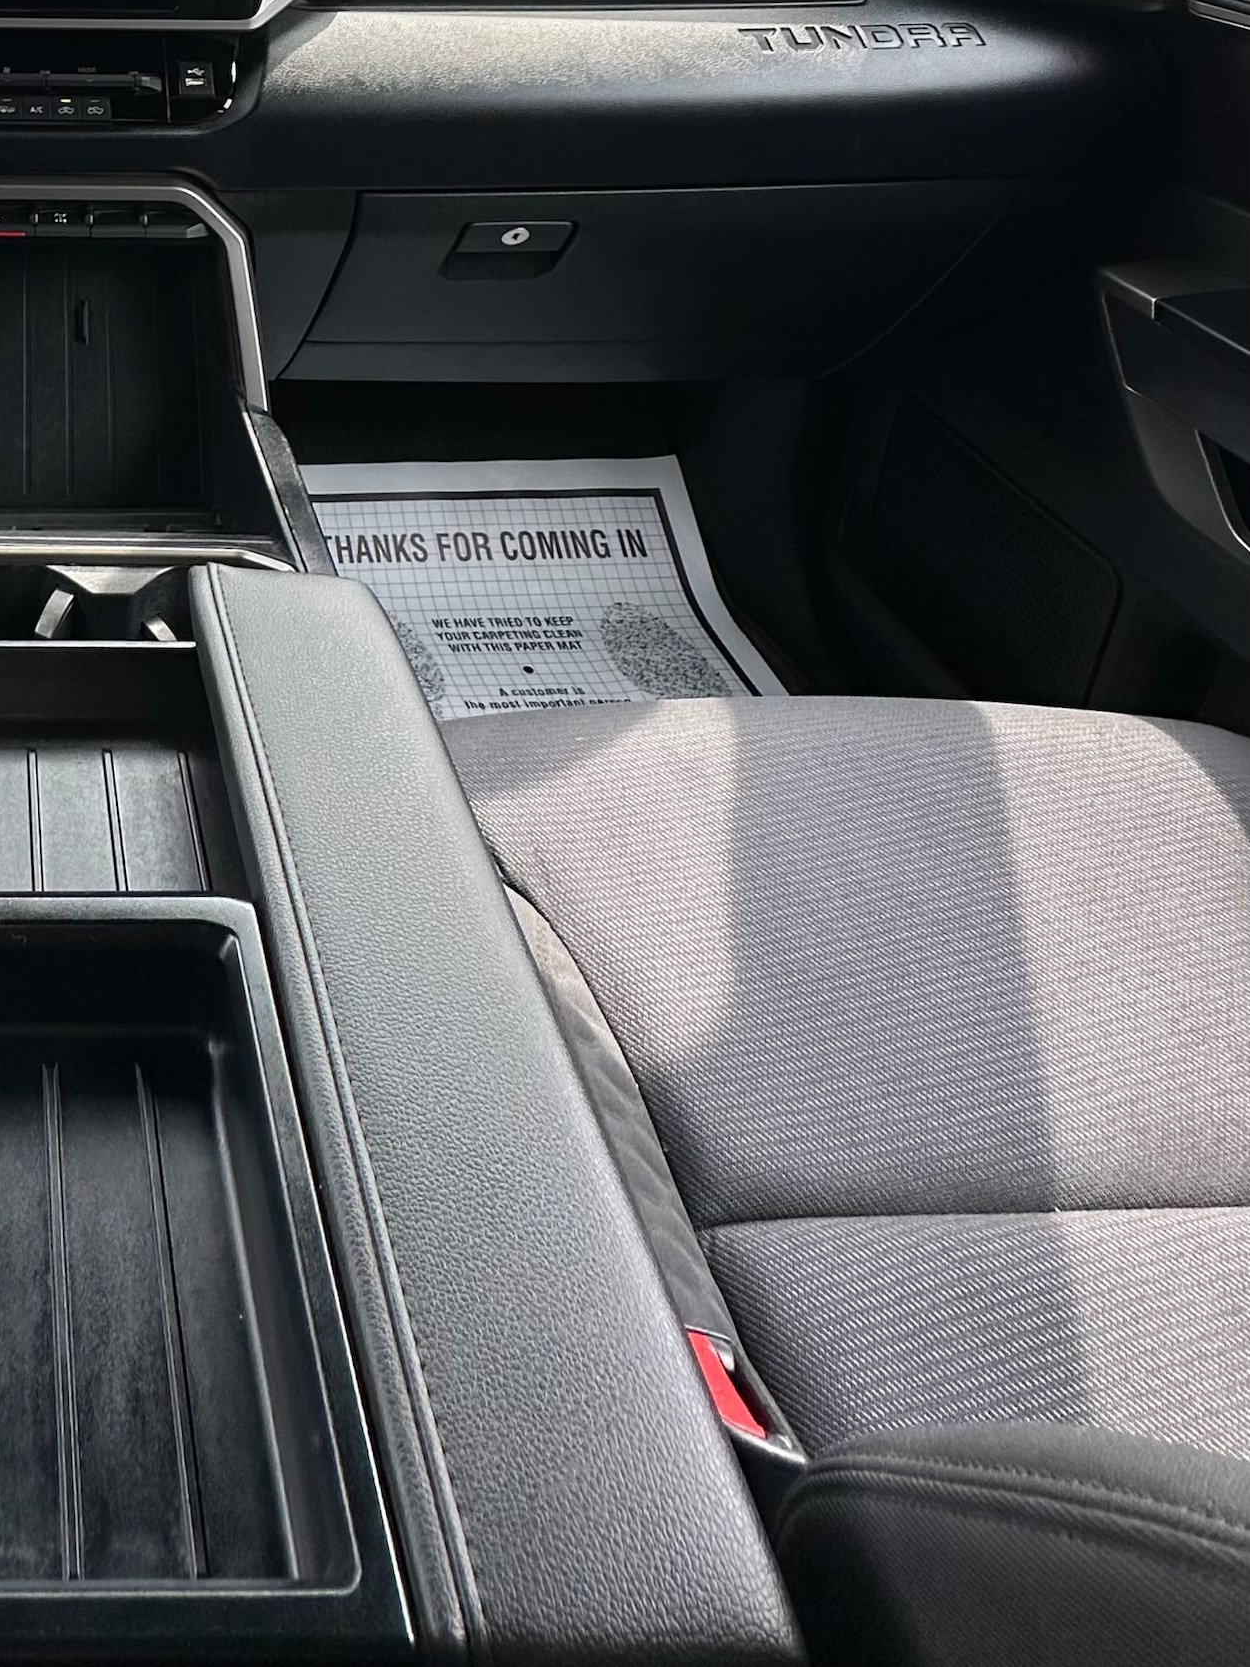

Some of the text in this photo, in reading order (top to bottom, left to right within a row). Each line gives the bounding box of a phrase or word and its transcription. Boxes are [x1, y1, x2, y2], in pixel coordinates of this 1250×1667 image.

[737, 22, 986, 52] TUNDRA
[30, 106, 44, 115] A/C
[323, 527, 649, 564] THANKS FOR COMING IN
[432, 616, 574, 629] WE HAVE TRIED TO KEEP
[437, 629, 583, 641] YOUR CARPETING CLEAN
[448, 641, 583, 653] WITH THIS PAPER MAT
[499, 686, 586, 697] A customer is
[465, 700, 486, 711] the
[489, 700, 521, 709] most
[525, 698, 586, 710] important
